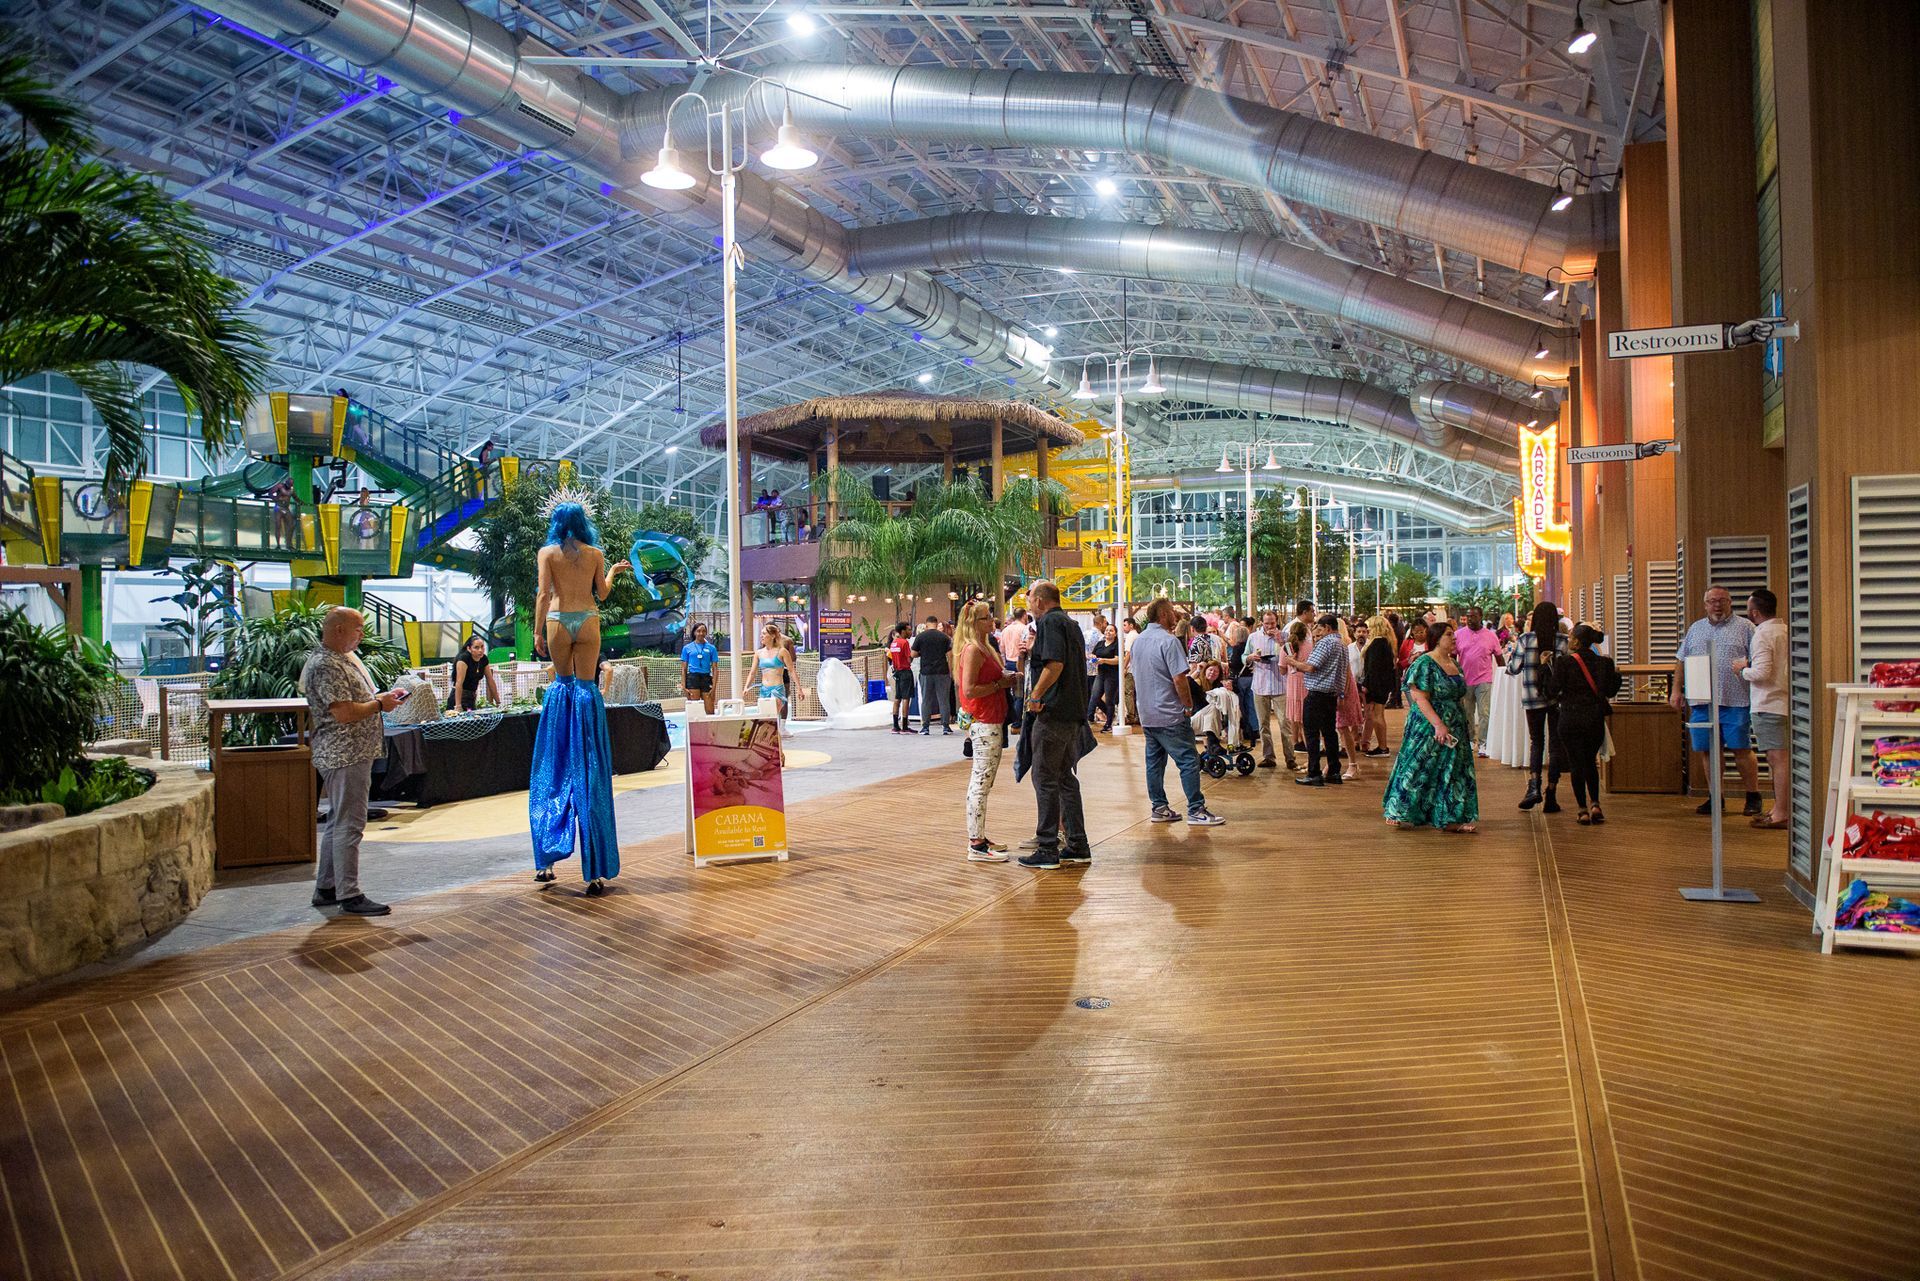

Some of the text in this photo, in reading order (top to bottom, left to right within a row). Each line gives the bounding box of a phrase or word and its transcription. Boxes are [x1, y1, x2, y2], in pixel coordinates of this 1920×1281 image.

[1615, 332, 1718, 351] Restrooms
[1571, 448, 1634, 460] Restrooms
[1534, 445, 1544, 530] ARCADE
[715, 812, 765, 826] CABANA
[714, 826, 743, 835] Available
[752, 825, 767, 833] Rent
